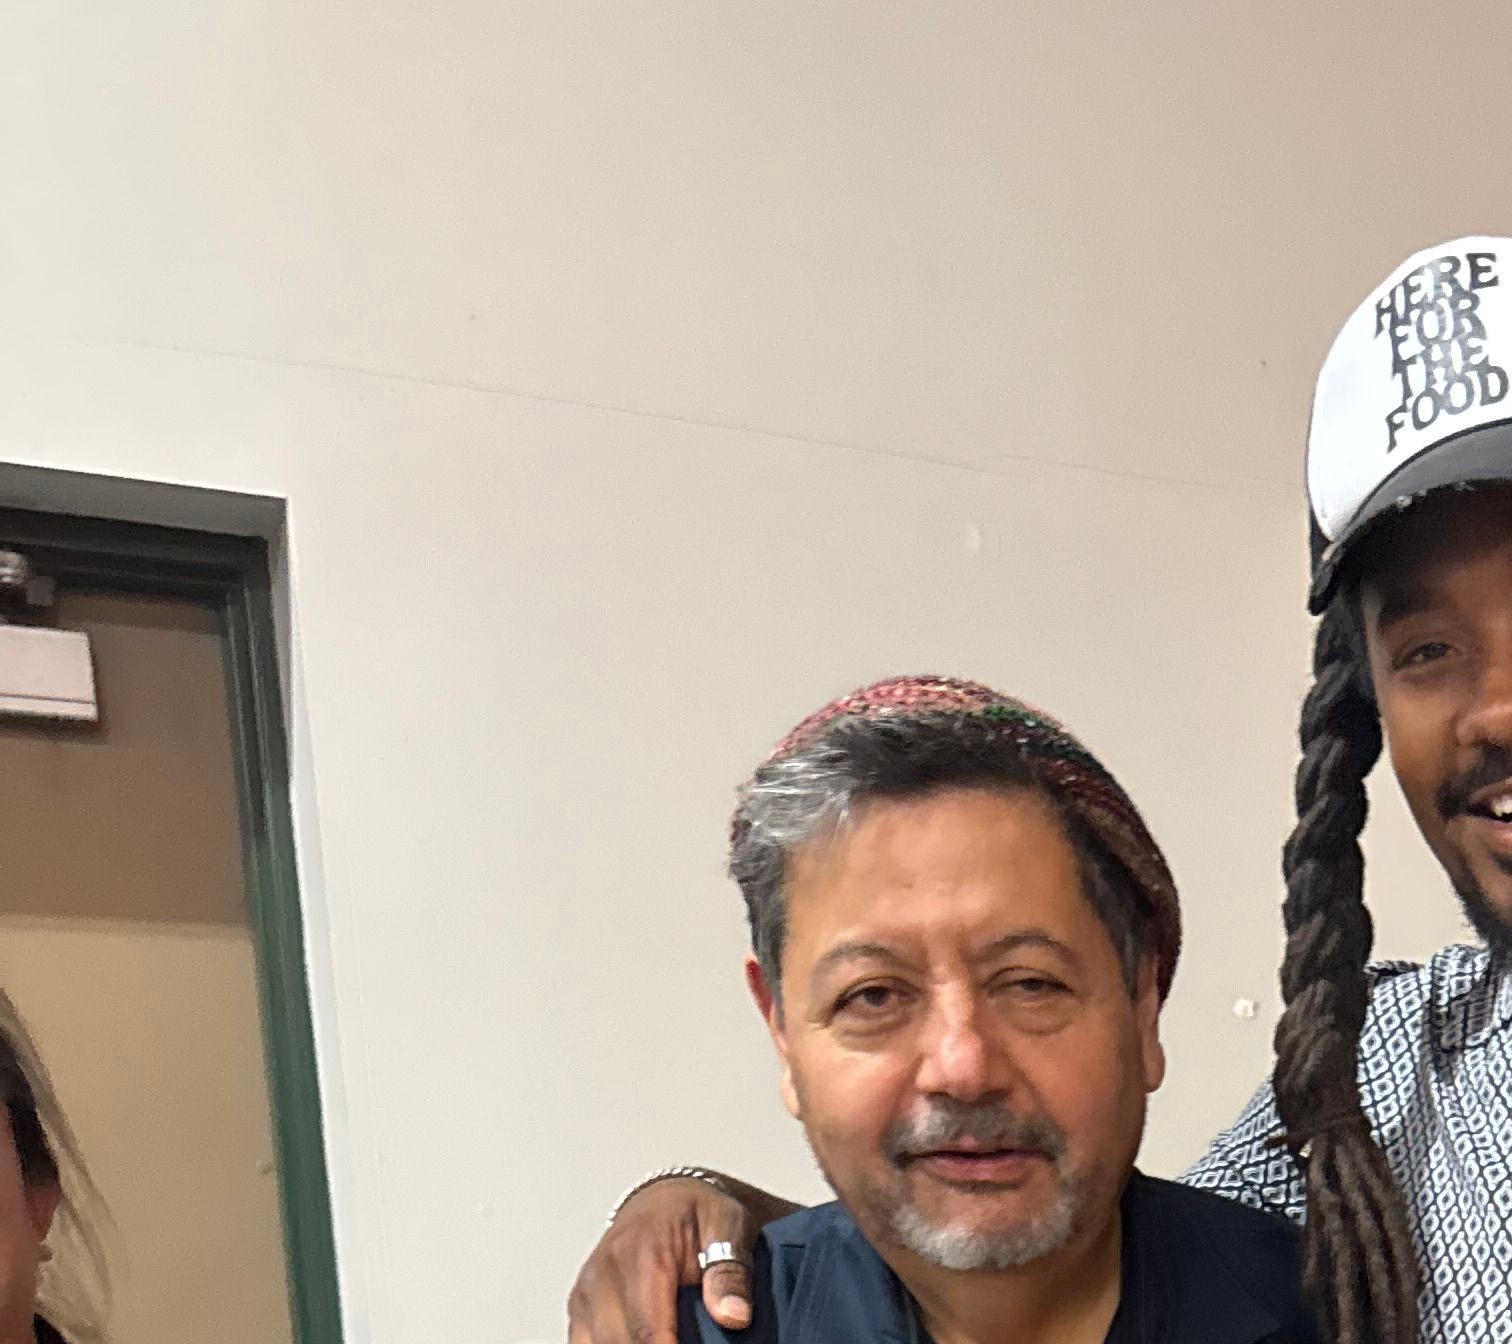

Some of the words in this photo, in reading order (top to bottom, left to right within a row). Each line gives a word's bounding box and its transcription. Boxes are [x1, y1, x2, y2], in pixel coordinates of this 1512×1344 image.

[1373, 252, 1499, 340] HERE
[1389, 289, 1488, 382] FOR
[1386, 362, 1509, 454] FOOD
[1395, 332, 1490, 408] THE
